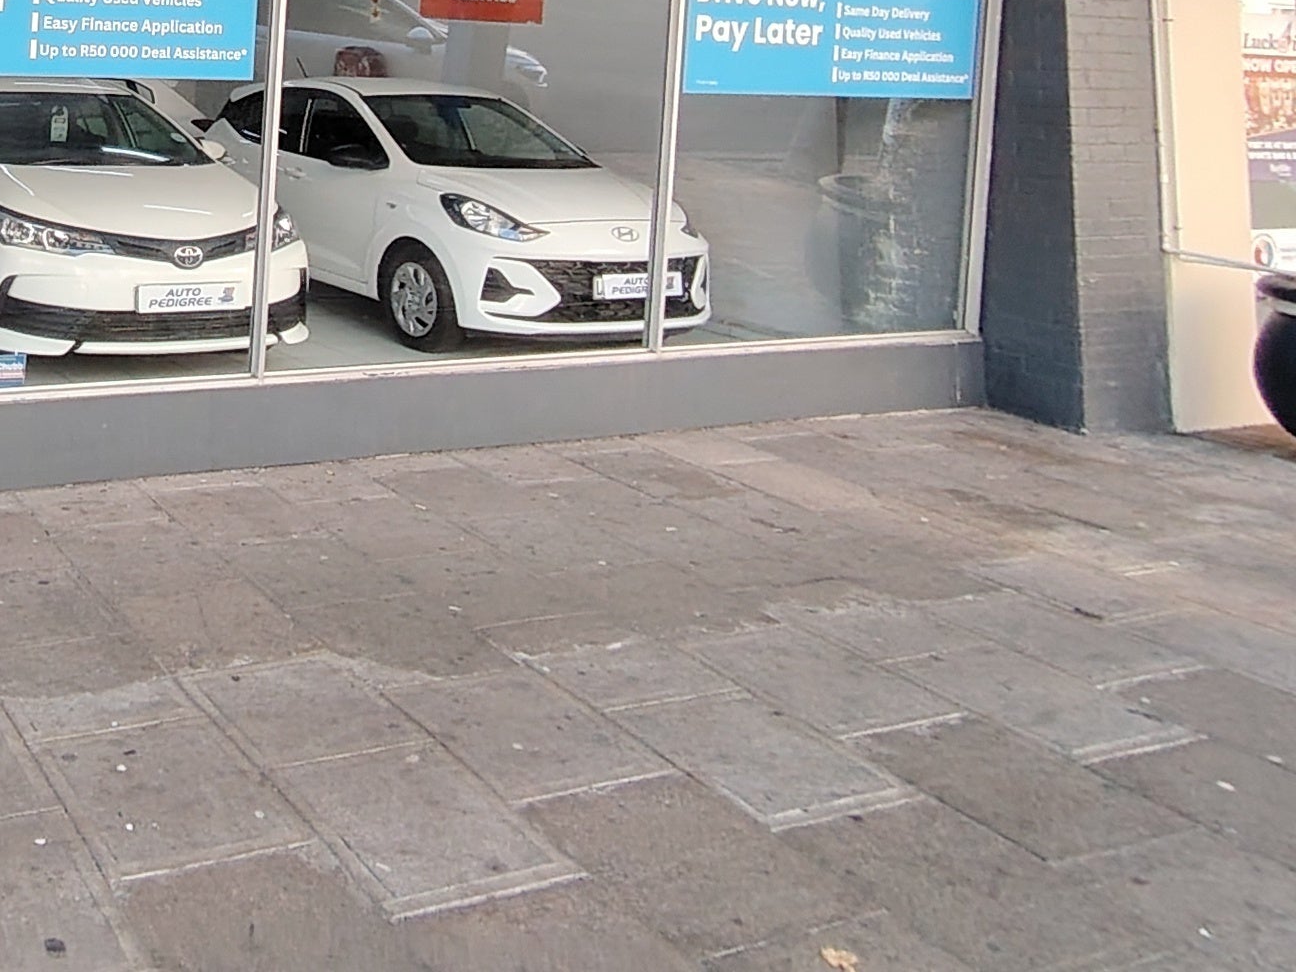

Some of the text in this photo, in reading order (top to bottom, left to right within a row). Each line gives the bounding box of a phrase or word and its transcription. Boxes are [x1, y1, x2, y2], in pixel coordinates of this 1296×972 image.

[844, 5, 931, 21] Same Day Delivery
[43, 16, 223, 36] Easy Finance Application
[695, 14, 824, 52] Pay Later
[842, 26, 942, 42] Quality Used Vehicles
[39, 43, 59, 58] Up
[61, 45, 77, 57] to
[80, 44, 106, 58] R50
[110, 45, 138, 58] 000
[141, 46, 171, 59] Deal
[841, 48, 954, 64] Easy Finance Application
[838, 70, 849, 82] Up
[853, 72, 862, 81] to
[863, 71, 881, 82] R50
[882, 72, 900, 82] 000
[903, 72, 921, 83] Deal
[165, 287, 202, 298] AUTO
[611, 286, 649, 295] PEDIGR
[148, 296, 213, 308] PEDIGREE
